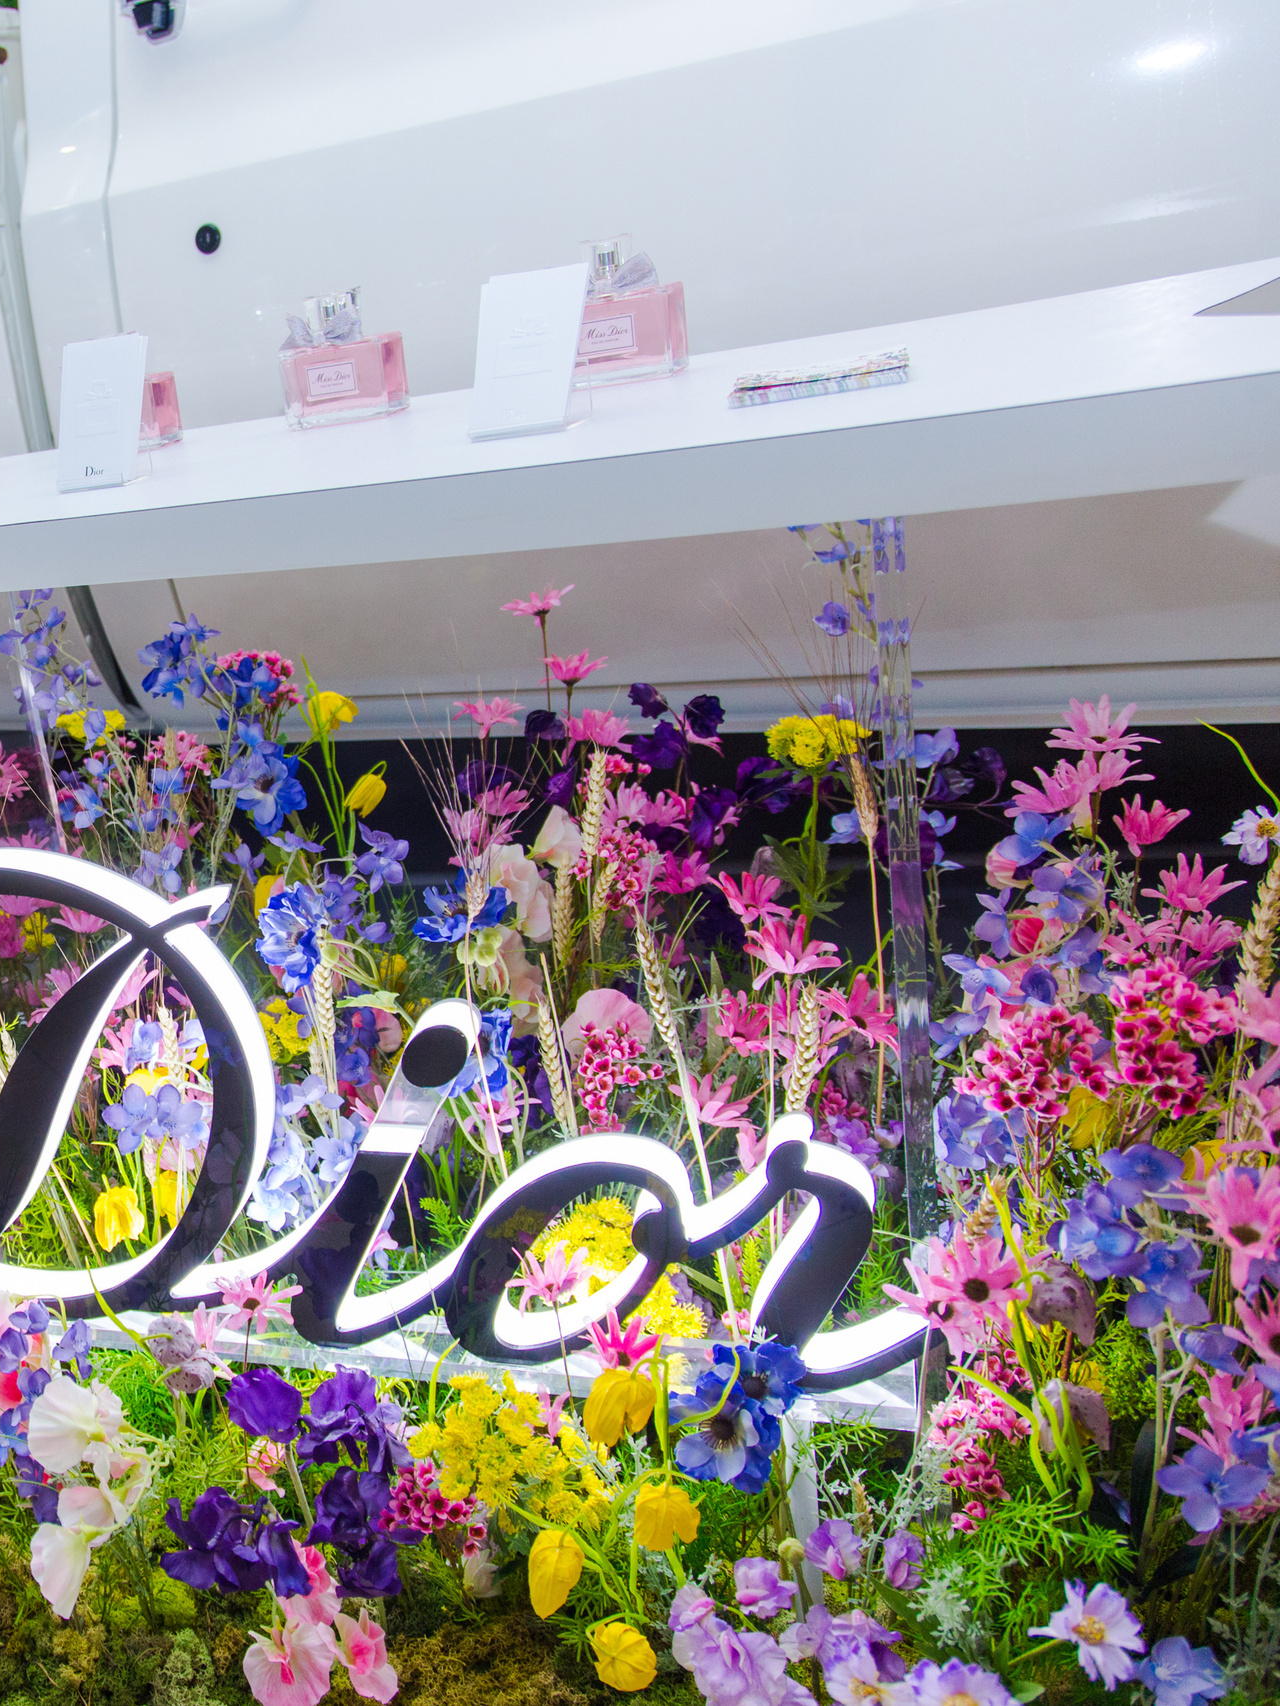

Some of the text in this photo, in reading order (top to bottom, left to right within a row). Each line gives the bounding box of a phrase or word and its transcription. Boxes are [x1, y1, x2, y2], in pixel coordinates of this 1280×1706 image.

[580, 325, 628, 341] Miss Dior
[312, 370, 351, 384] Miss Dior
[84, 466, 105, 477] Dior
